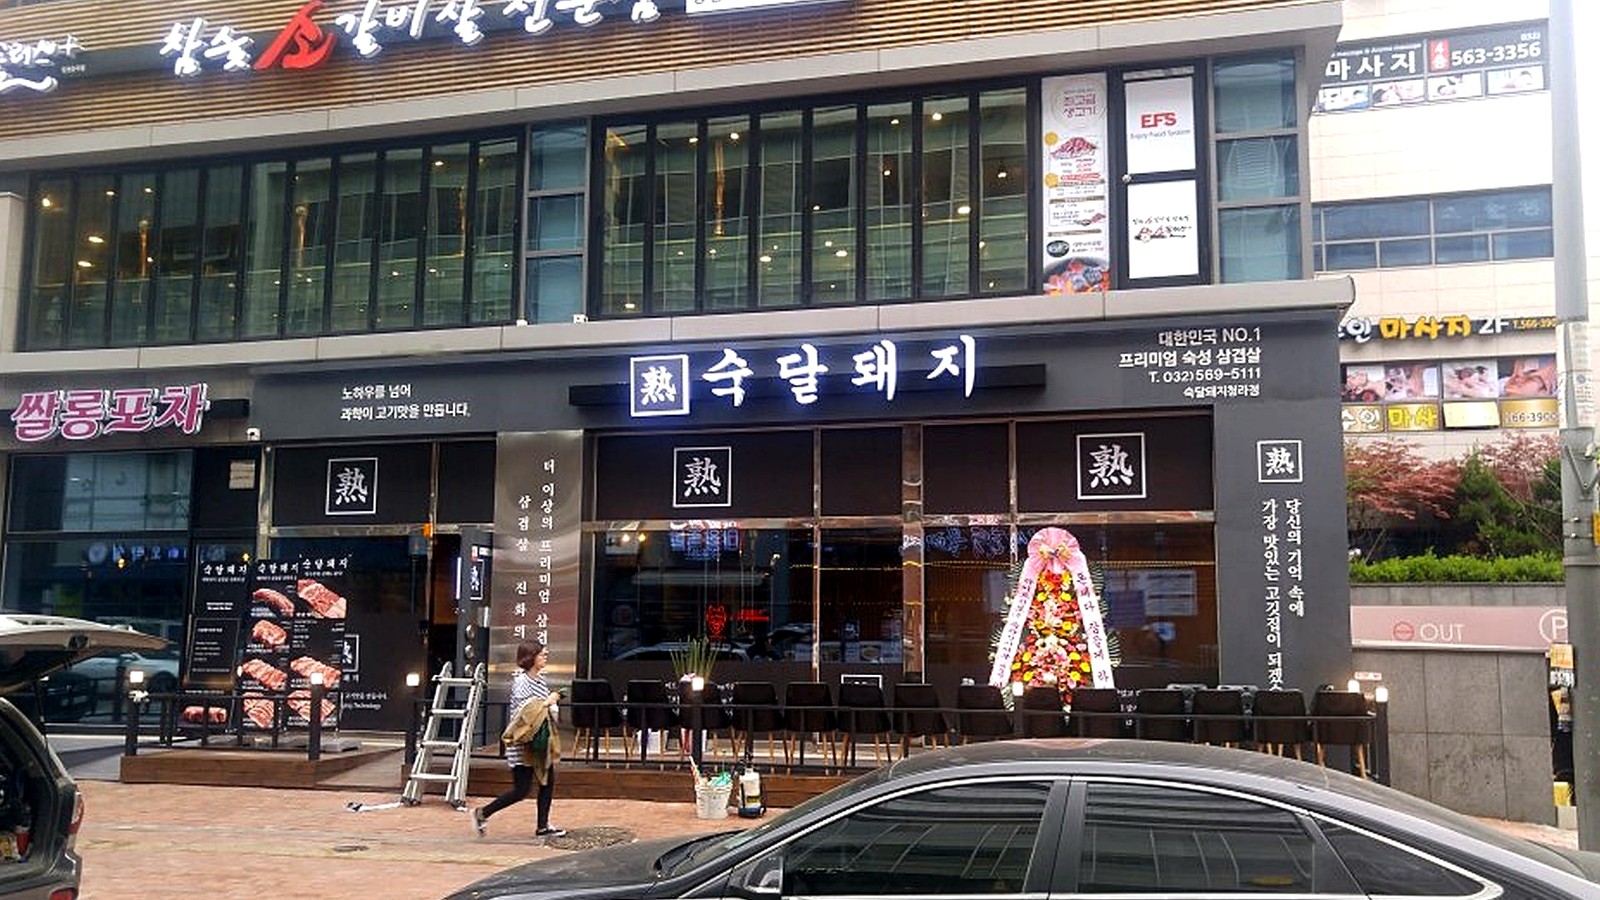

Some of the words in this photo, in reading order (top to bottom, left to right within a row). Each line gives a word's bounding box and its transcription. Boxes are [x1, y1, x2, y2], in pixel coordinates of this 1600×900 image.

[1325, 50, 1416, 81] 마사지
[1451, 41, 1541, 66] 563-3356
[1141, 112, 1177, 128] EFS
[1158, 328, 1217, 347] 대한민국
[1222, 327, 1261, 343] NO.1
[1380, 315, 1472, 339] 마사지
[1479, 317, 1510, 335] 2F
[702, 335, 976, 407] 숙달돼지
[1119, 351, 1177, 368] 프리미엄
[1182, 349, 1211, 366] 숙성
[1216, 347, 1261, 364] 삼겹살
[1149, 371, 1160, 383] T.
[1163, 367, 1261, 383] 032)569-5111
[341, 385, 386, 400] 노하우를
[388, 383, 412, 399] 넘어
[11, 383, 209, 441] 쌀롱포차
[340, 406, 373, 421] 과학이
[375, 403, 420, 419] 고기맛을
[423, 402, 471, 418] 만듭니다.
[543, 459, 555, 475] 더
[540, 483, 555, 530] 이상의
[1261, 498, 1279, 531] 가장
[1284, 499, 1302, 545] 당신의
[516, 495, 532, 551] 삼겹살
[538, 540, 552, 604] 프리미엄
[1263, 534, 1280, 581] 맛있는
[1287, 549, 1303, 581] 기억
[513, 581, 527, 639] 진화의
[1288, 585, 1305, 617] 속에
[1265, 586, 1281, 648] 고깃집이
[1420, 622, 1465, 641] OUT
[1551, 616, 1568, 639] P
